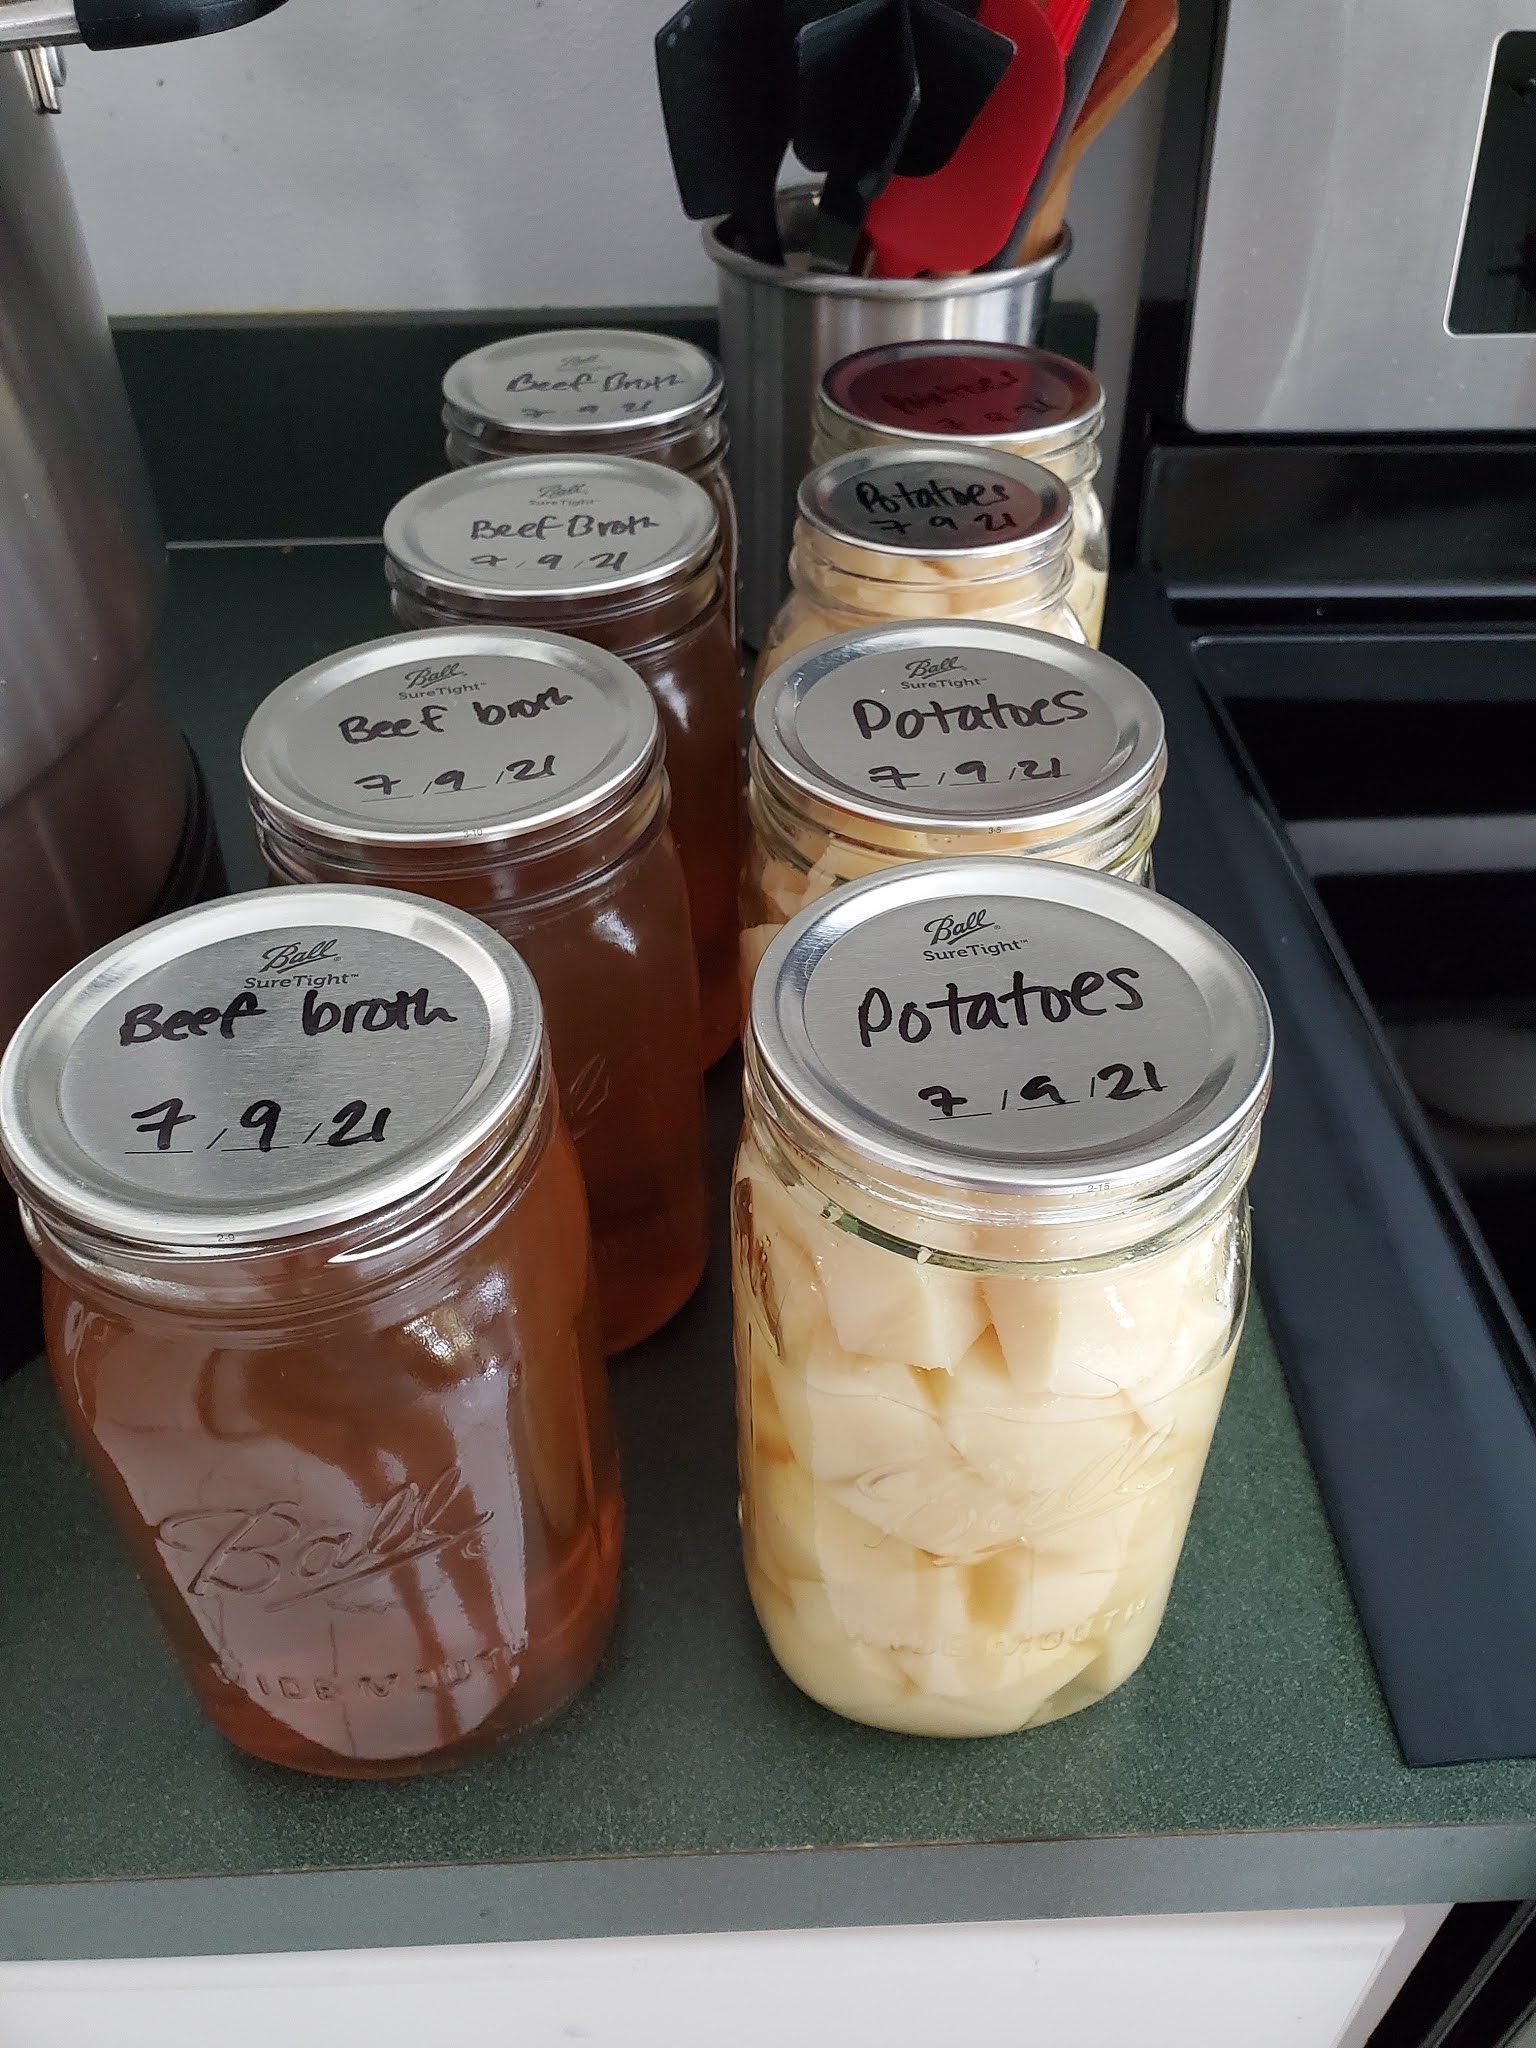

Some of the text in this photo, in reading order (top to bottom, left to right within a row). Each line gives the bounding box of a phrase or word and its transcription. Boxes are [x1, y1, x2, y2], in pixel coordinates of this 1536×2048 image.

[856, 479, 1011, 514] Potatoes
[470, 515, 564, 540] Beef
[404, 662, 464, 689] Ball
[904, 656, 966, 680] Ball
[338, 704, 449, 745] Beef
[852, 690, 1090, 740] Potatoes
[923, 908, 997, 946] Ball
[261, 938, 340, 975] Ball
[118, 987, 458, 1047] Beef broth
[858, 965, 1145, 1048] Potatoes
[156, 1466, 496, 1613] Ball
